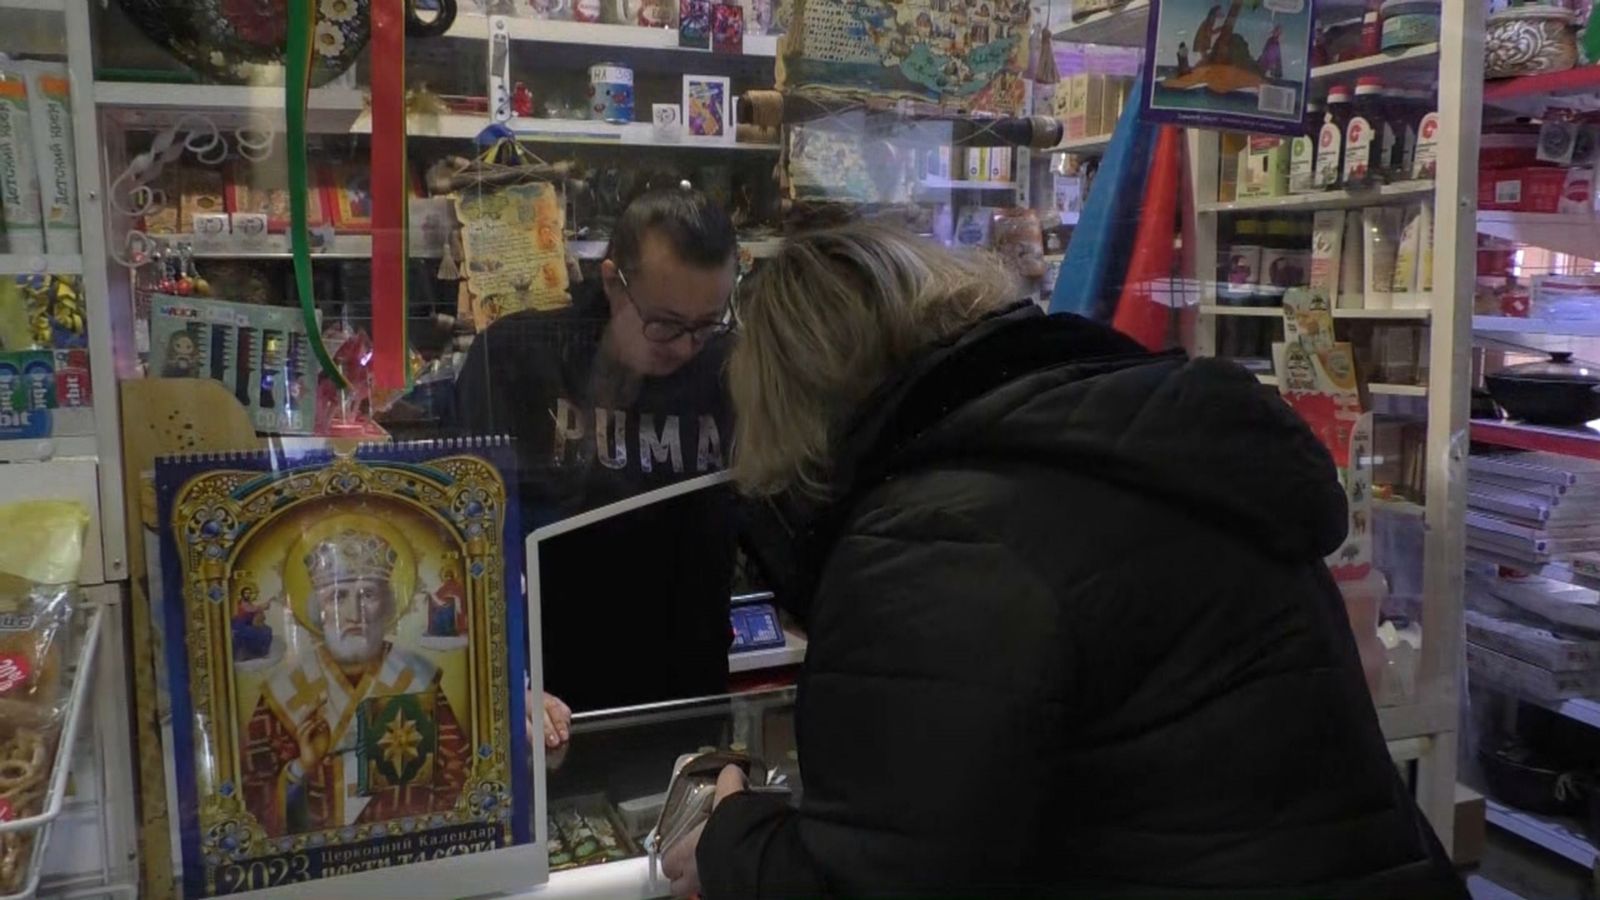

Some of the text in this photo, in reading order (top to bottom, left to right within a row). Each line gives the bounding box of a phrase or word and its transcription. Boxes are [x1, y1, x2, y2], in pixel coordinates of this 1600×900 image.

[47, 103, 69, 205] Детский крем
[67, 375, 80, 407] rbit
[0, 411, 33, 426] bit
[553, 398, 724, 473] PUMA
[321, 826, 497, 863] Церковний Календар
[222, 854, 312, 893] 2023
